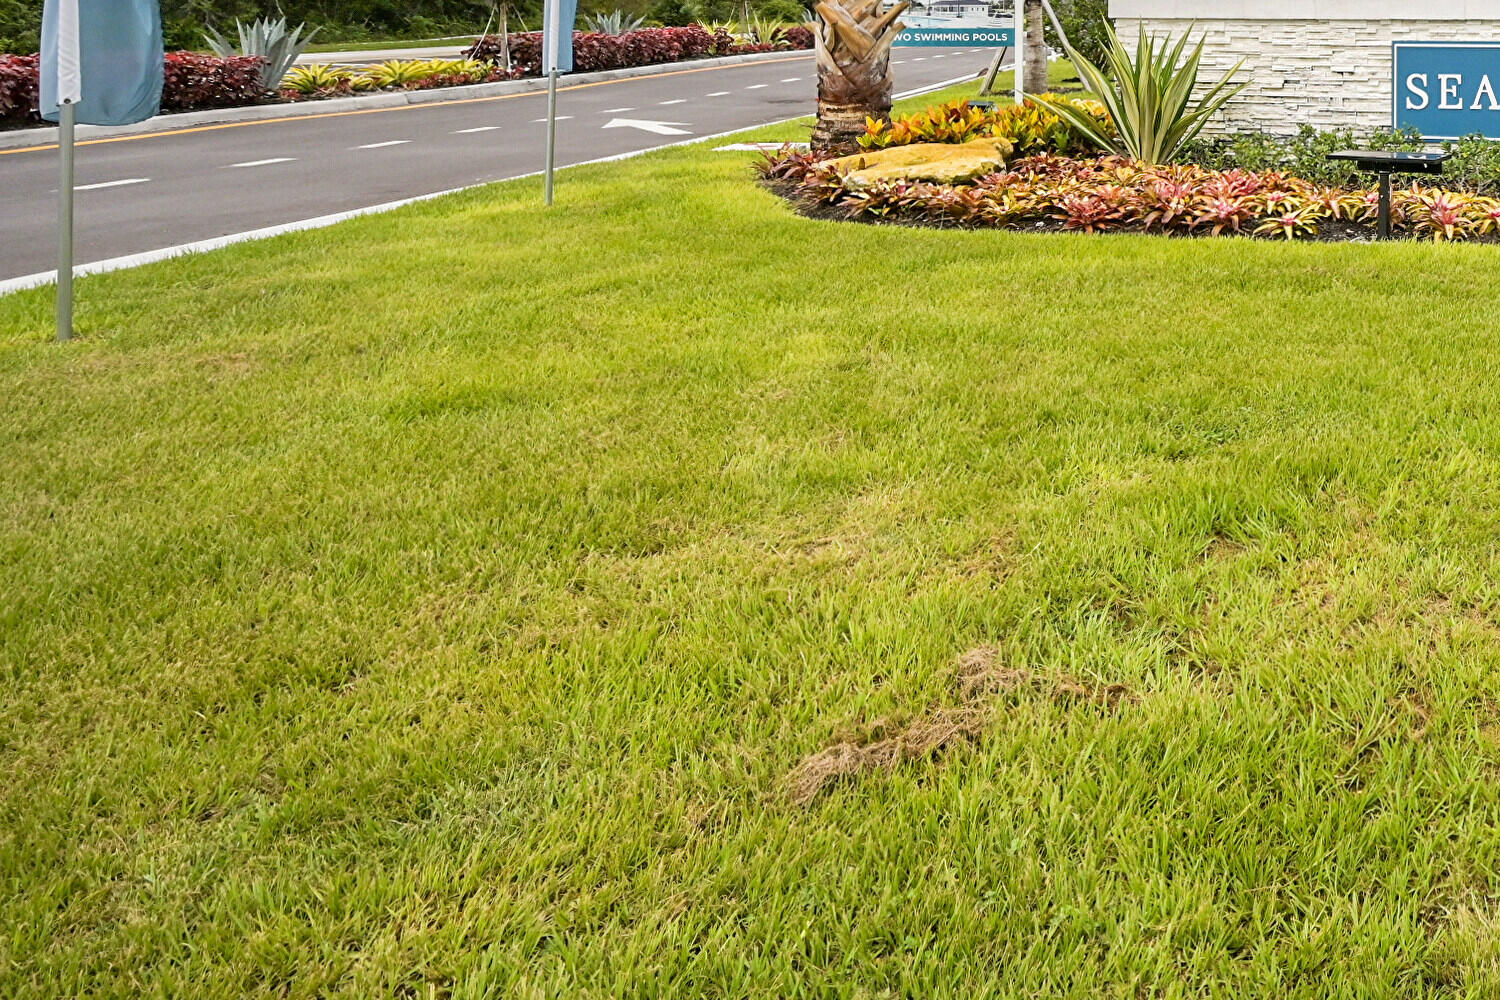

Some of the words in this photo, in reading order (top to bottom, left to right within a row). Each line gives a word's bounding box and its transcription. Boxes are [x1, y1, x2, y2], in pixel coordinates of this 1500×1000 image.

[893, 33, 912, 42] WO
[914, 33, 970, 42] SWIMMING
[972, 33, 1008, 42] POOLS
